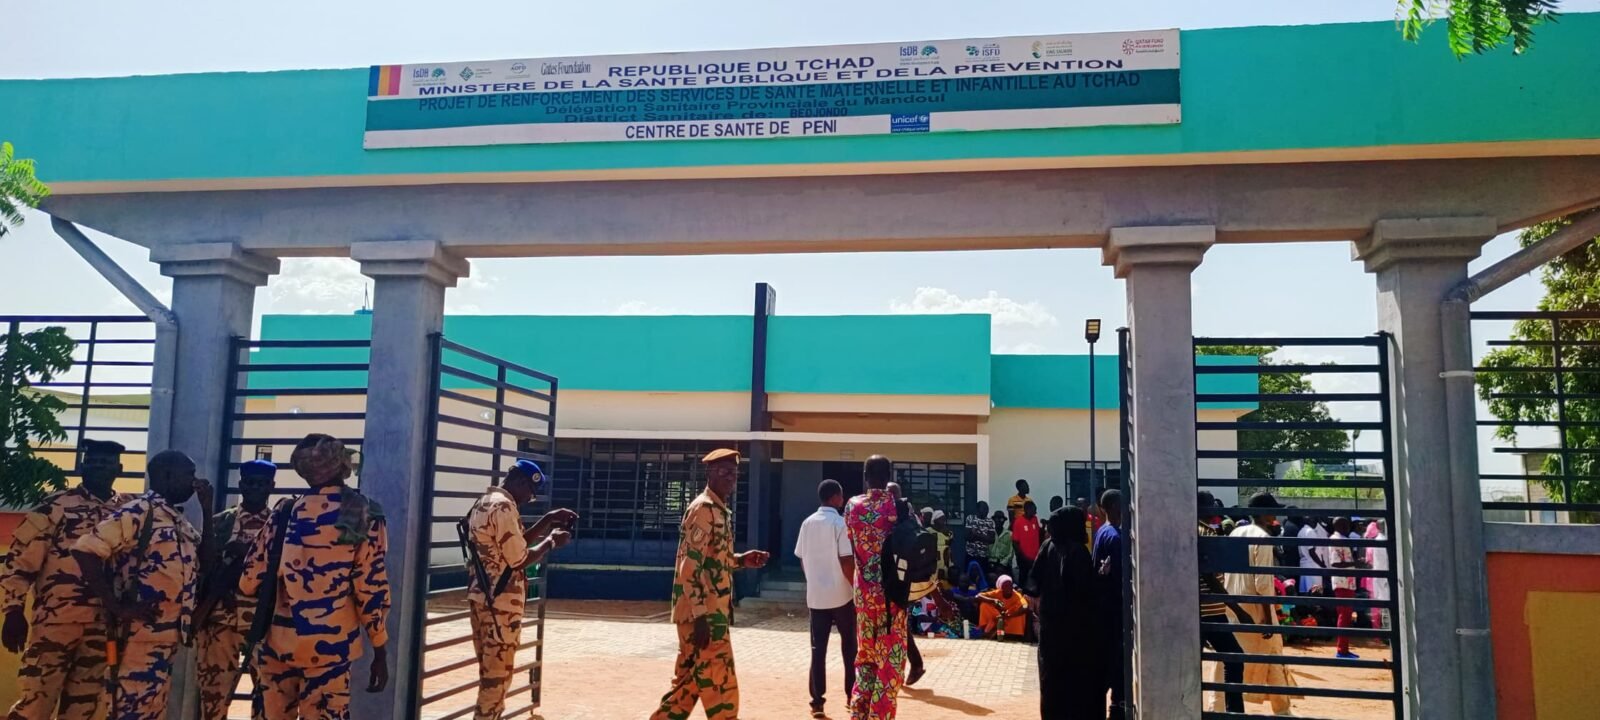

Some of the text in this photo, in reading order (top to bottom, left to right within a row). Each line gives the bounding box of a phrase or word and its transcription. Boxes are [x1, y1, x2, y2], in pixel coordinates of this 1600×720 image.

[608, 56, 875, 77] REPUBLIQUE DU TCHAD
[419, 81, 536, 96] MINISTERE
[544, 80, 574, 91] DE
[582, 78, 611, 89] LA
[619, 76, 697, 88] SANTE
[706, 71, 828, 86] PUBLIQUE
[837, 69, 868, 80] ET
[876, 67, 909, 78] DE
[914, 66, 947, 76] LA
[955, 59, 1123, 75] PREVENTION
[419, 71, 1141, 112] PROJET DE RENFORCEMENT DES SERVICES DE SANTE MATERNELLE ET INFANTILLE AU TCHAD
[643, 101, 720, 113] Sanitaire
[728, 98, 828, 112] Provinciale
[834, 97, 858, 107] du
[863, 93, 946, 106] Mandoul
[564, 113, 638, 123] District
[643, 111, 734, 122] Sanitaire
[892, 114, 918, 124] unicef
[625, 119, 837, 140] CENTRE DE SANTE DE PENI
